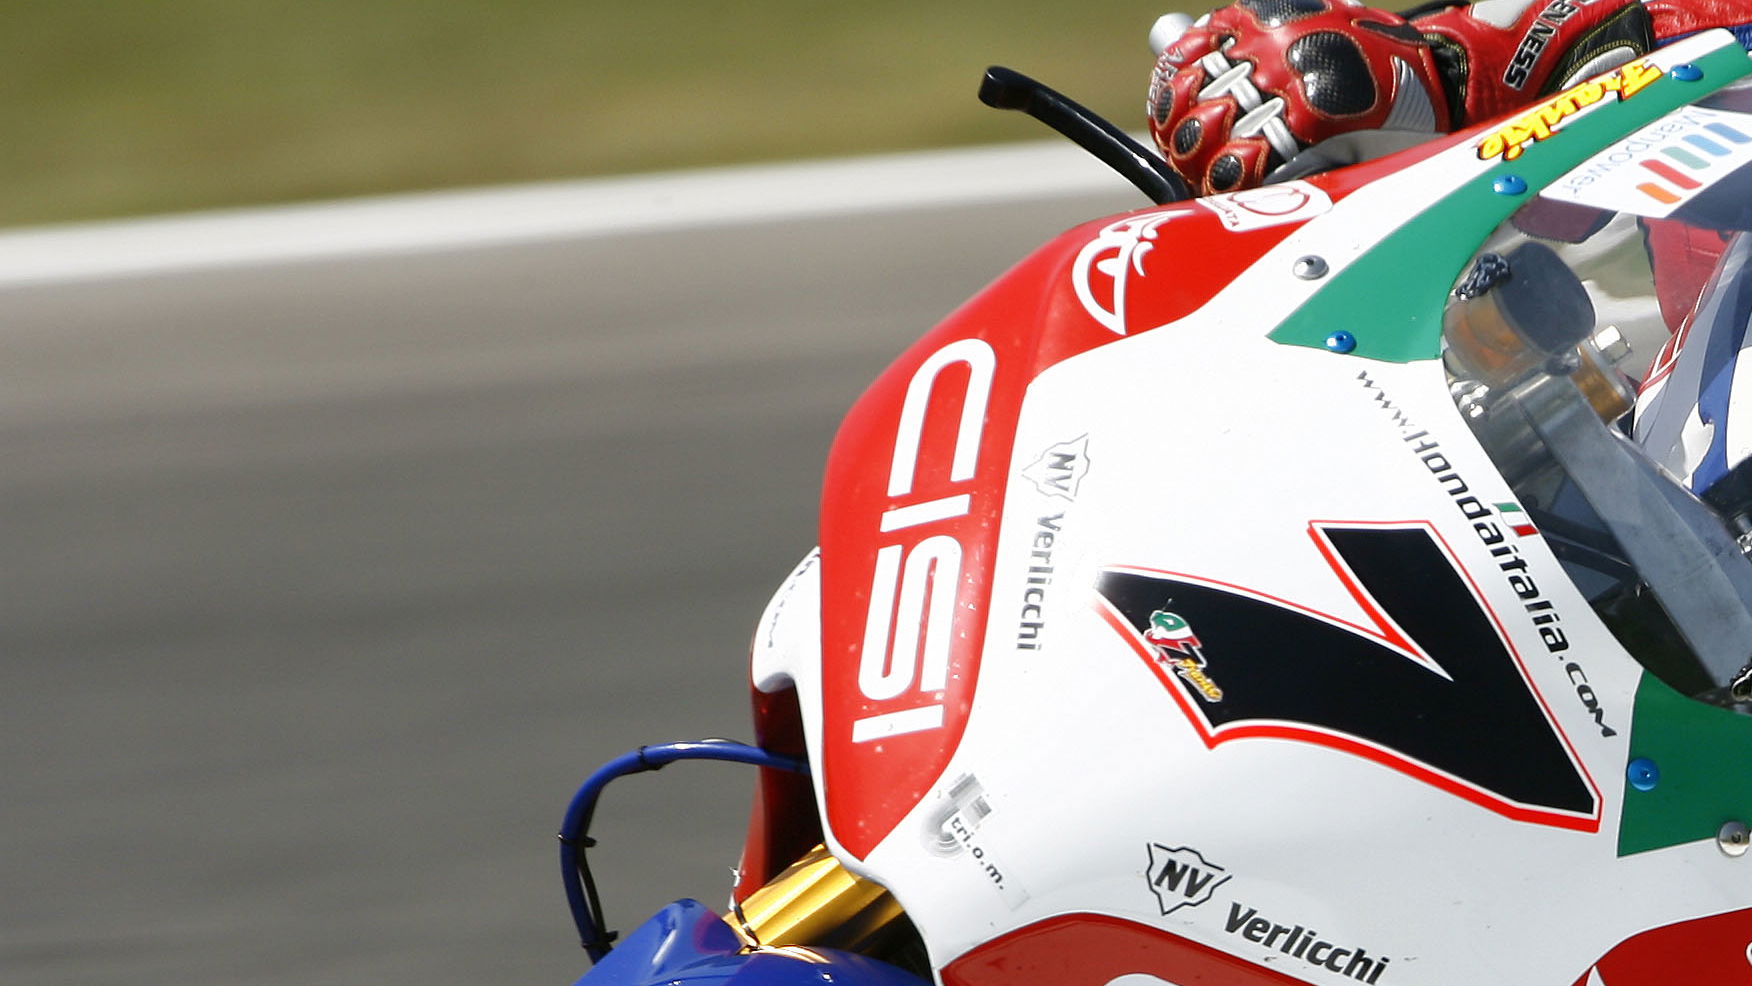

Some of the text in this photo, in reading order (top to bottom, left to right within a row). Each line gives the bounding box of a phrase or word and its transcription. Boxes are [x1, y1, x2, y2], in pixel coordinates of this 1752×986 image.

[850, 337, 997, 744] CISI
[1016, 511, 1066, 651] Verlicchi
[1095, 519, 1603, 834] 7
[1152, 858, 1214, 899] NV
